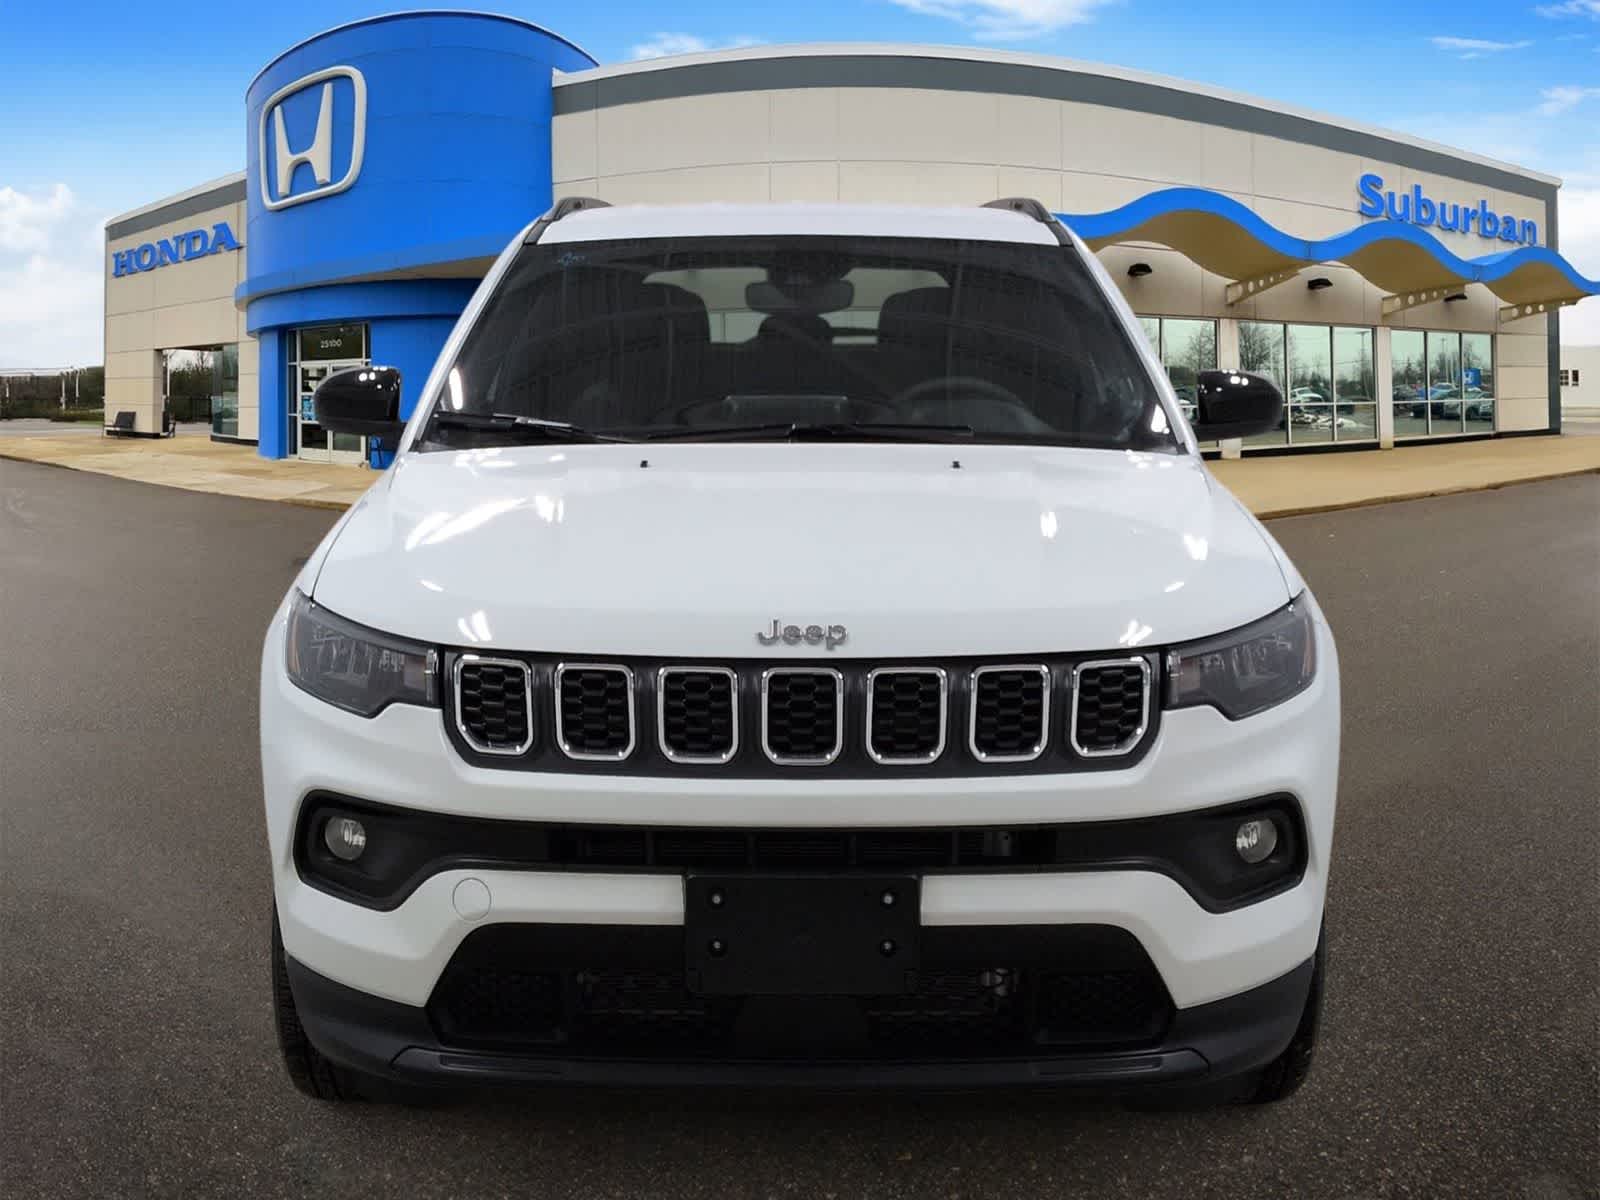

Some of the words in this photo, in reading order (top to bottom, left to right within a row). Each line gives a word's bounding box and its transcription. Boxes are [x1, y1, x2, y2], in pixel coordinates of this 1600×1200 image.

[1359, 173, 1537, 246] Suburban
[112, 221, 243, 278] HONDA
[757, 619, 847, 651] Jeep
